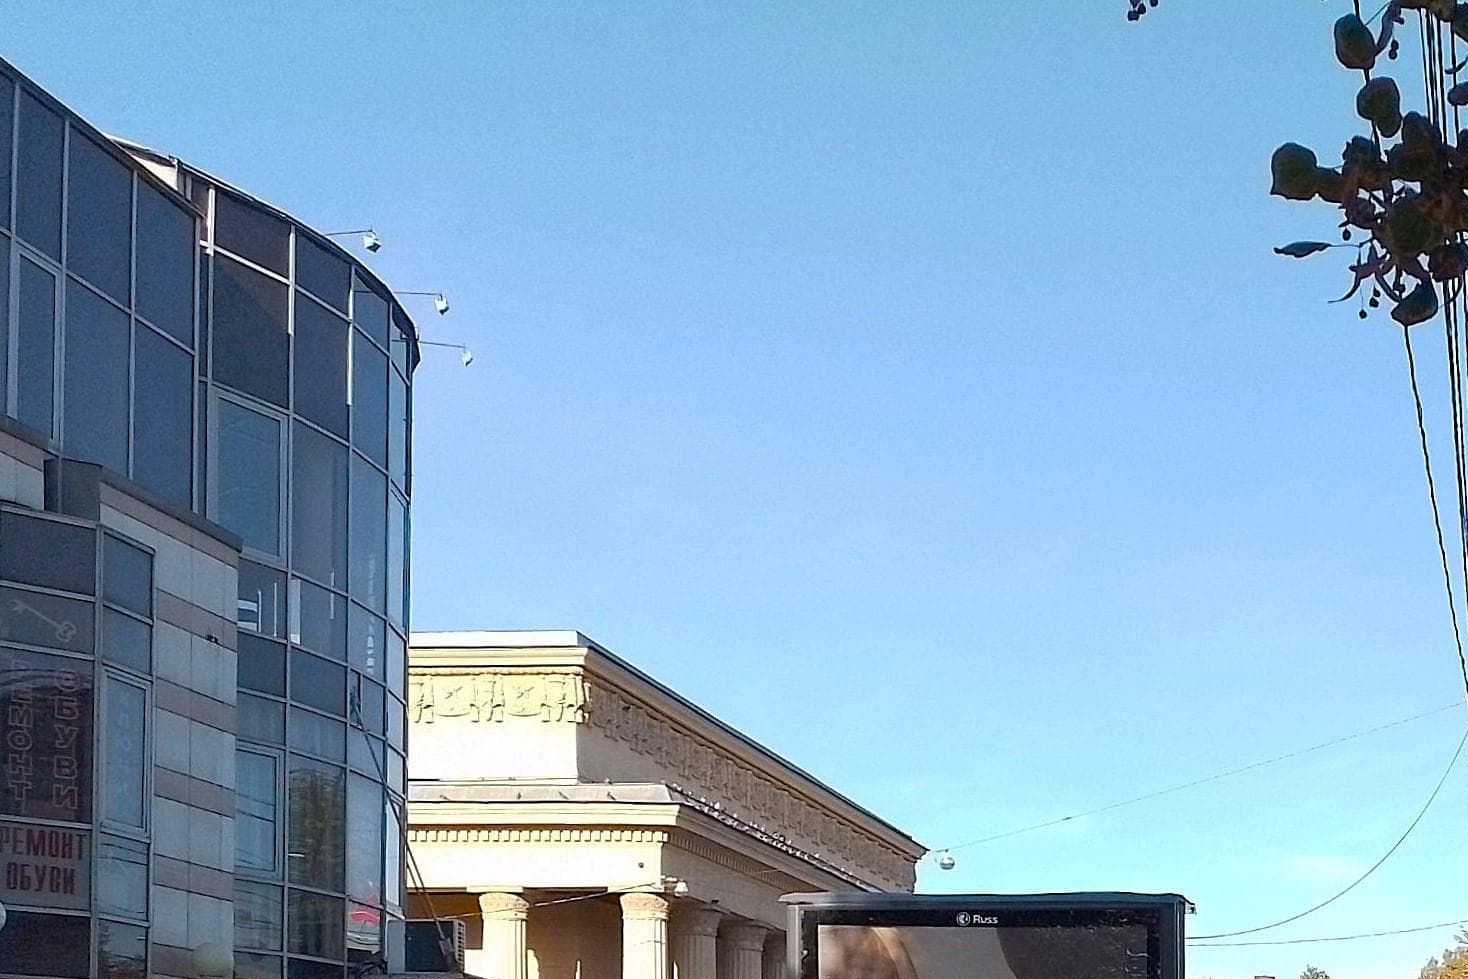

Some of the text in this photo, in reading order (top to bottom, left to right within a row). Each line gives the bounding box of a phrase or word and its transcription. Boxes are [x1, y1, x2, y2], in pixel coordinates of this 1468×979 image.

[53, 671, 80, 809] ОБУВИ
[7, 862, 75, 895] ОБУВИ
[972, 914, 999, 924] Russ
